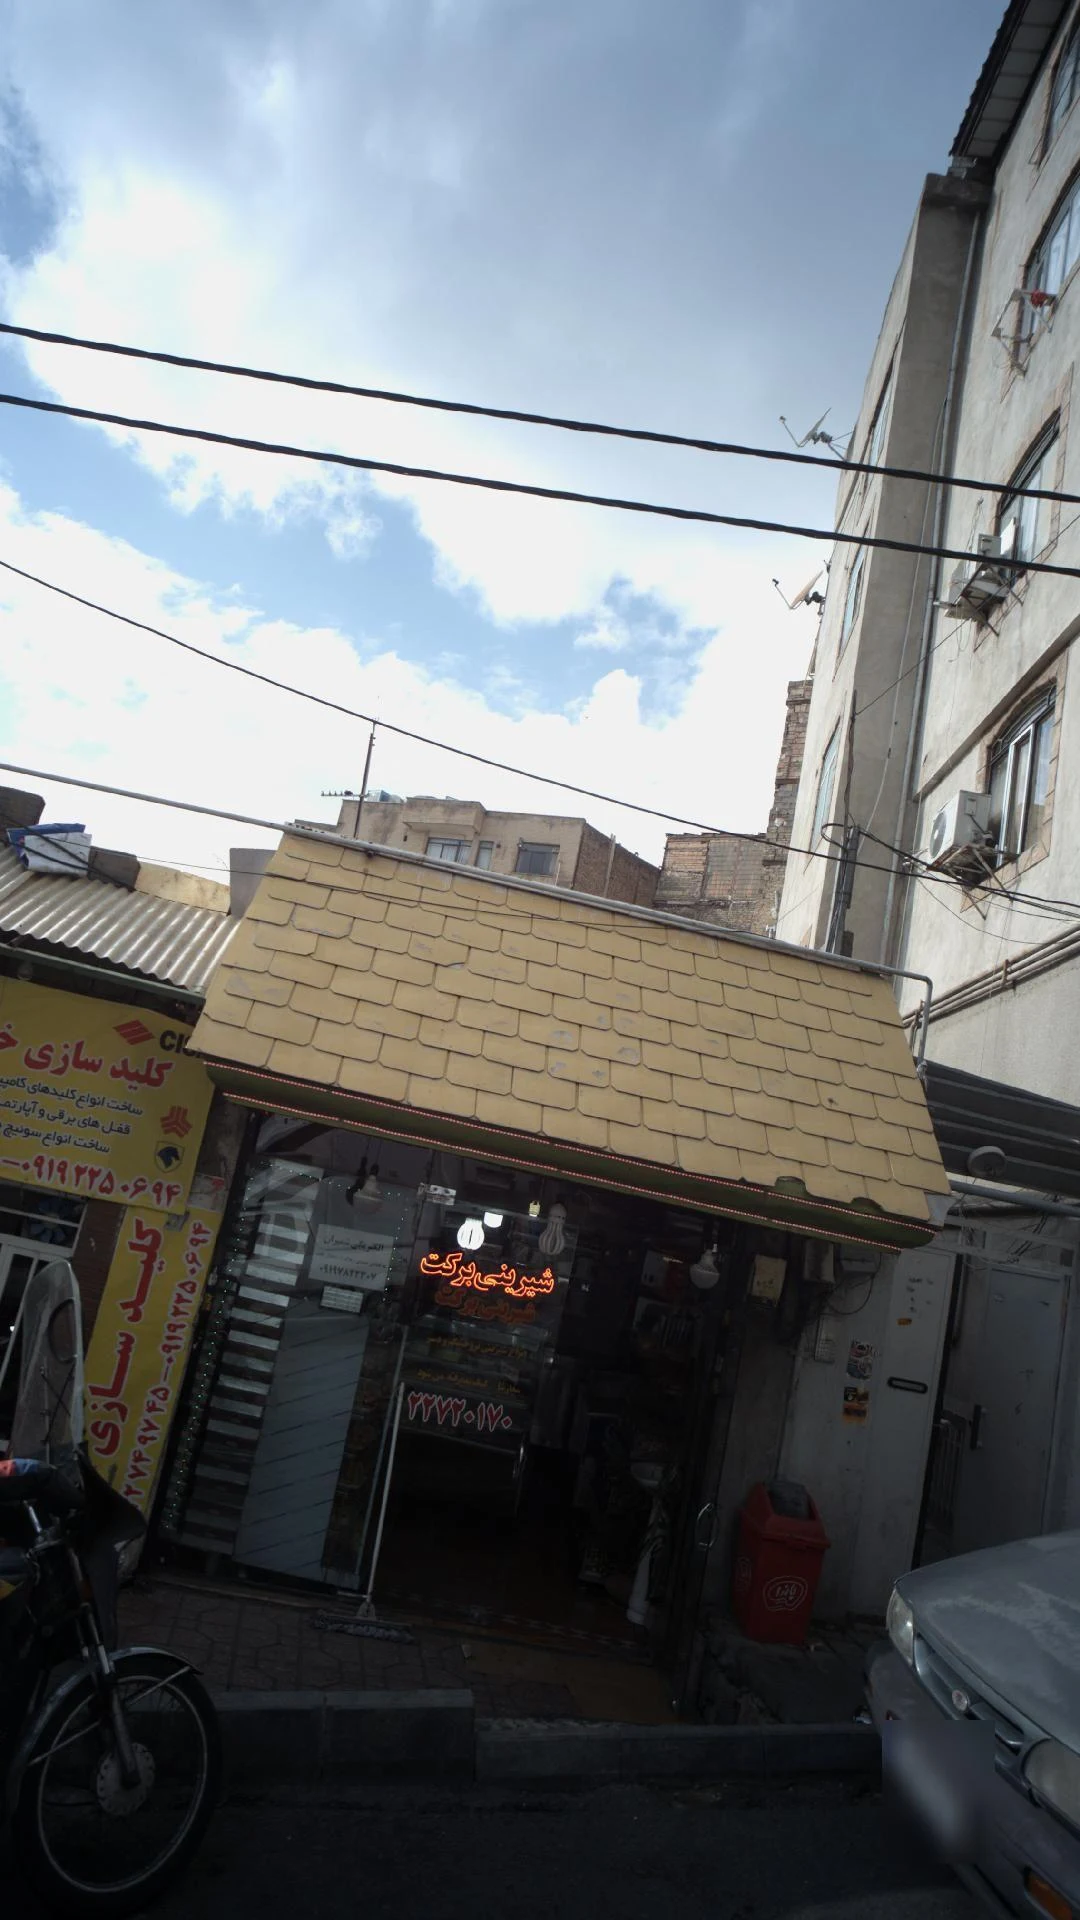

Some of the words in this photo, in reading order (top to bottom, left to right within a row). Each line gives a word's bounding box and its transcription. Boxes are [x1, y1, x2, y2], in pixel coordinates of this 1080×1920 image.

[24, 1040, 103, 1076] سازی
[110, 1057, 173, 1090] کلید
[75, 1094, 105, 1108] انواع
[106, 1100, 143, 1116] ساخت
[37, 1108, 46, 1119] و
[47, 1108, 76, 1125] برقی
[101, 1121, 131, 1135] قفل
[42, 1134, 71, 1147] انواع
[74, 1138, 110, 1153] ساخت
[119, 1218, 165, 1323] کلید
[420, 1252, 476, 1287] برکت
[474, 1264, 554, 1297] شیرینی
[88, 1331, 135, 1456] سازی
